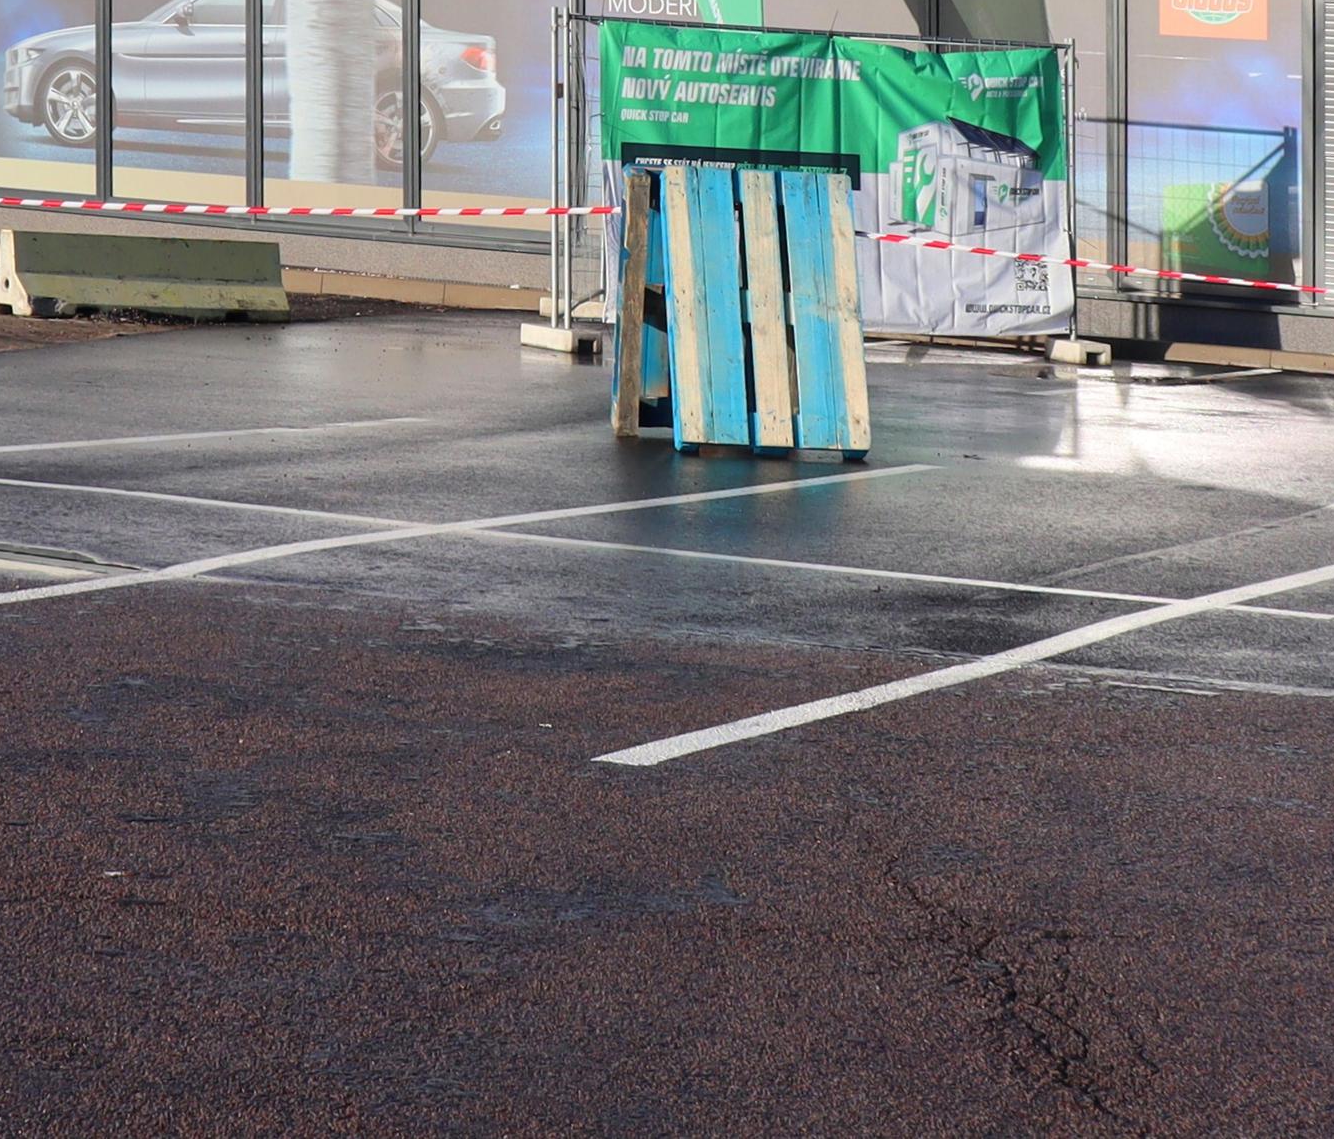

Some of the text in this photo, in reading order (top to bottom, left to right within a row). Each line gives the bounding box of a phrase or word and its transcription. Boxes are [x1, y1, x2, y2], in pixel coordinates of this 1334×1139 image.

[622, 46, 862, 82] NA TOMTO MÍSTĚ OTEVÍRÁME
[621, 74, 778, 107] NOVÝ AUTOSERVIS
[620, 108, 689, 124] QUICK STOP CAR
